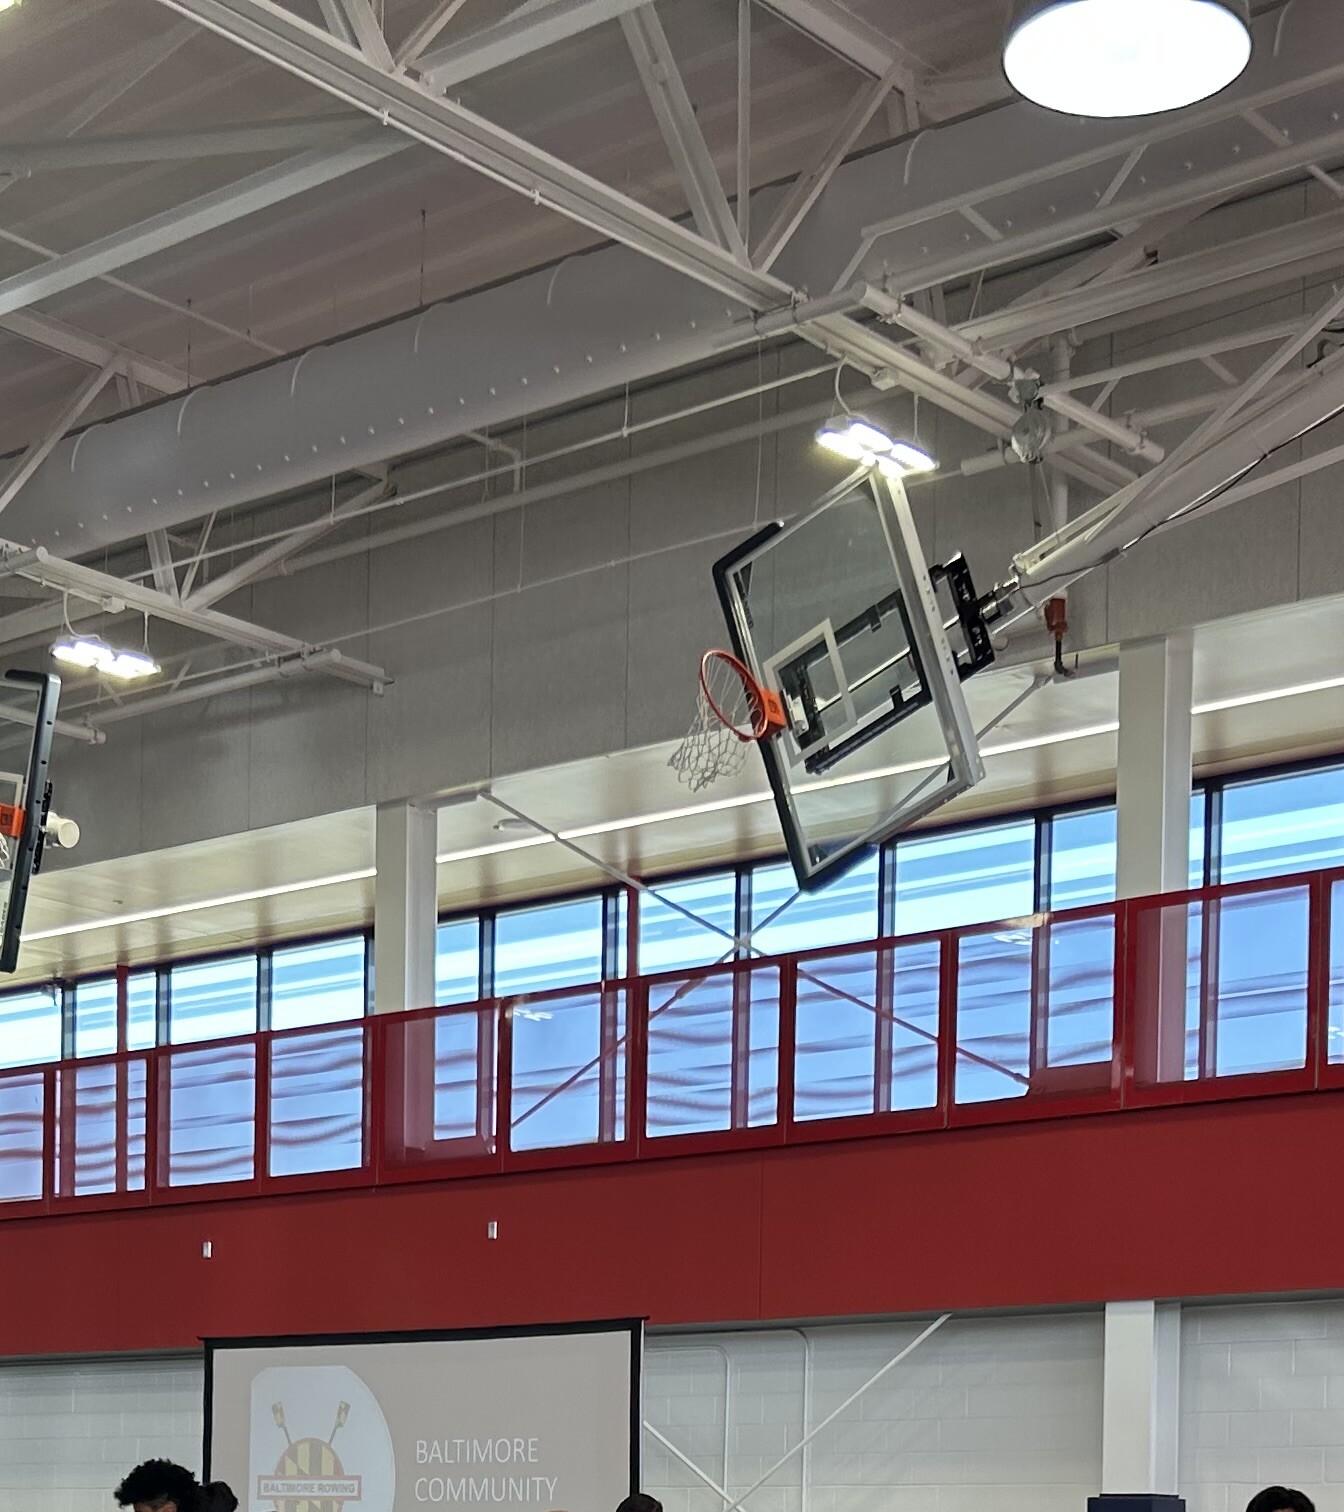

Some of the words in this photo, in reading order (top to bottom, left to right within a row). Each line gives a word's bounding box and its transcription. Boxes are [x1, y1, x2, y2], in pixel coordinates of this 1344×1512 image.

[415, 1437, 539, 1465] BALTIMORE
[263, 1482, 315, 1494] BALTIMORE
[317, 1483, 355, 1494] ROWING
[414, 1476, 559, 1502] COMMUNITY
